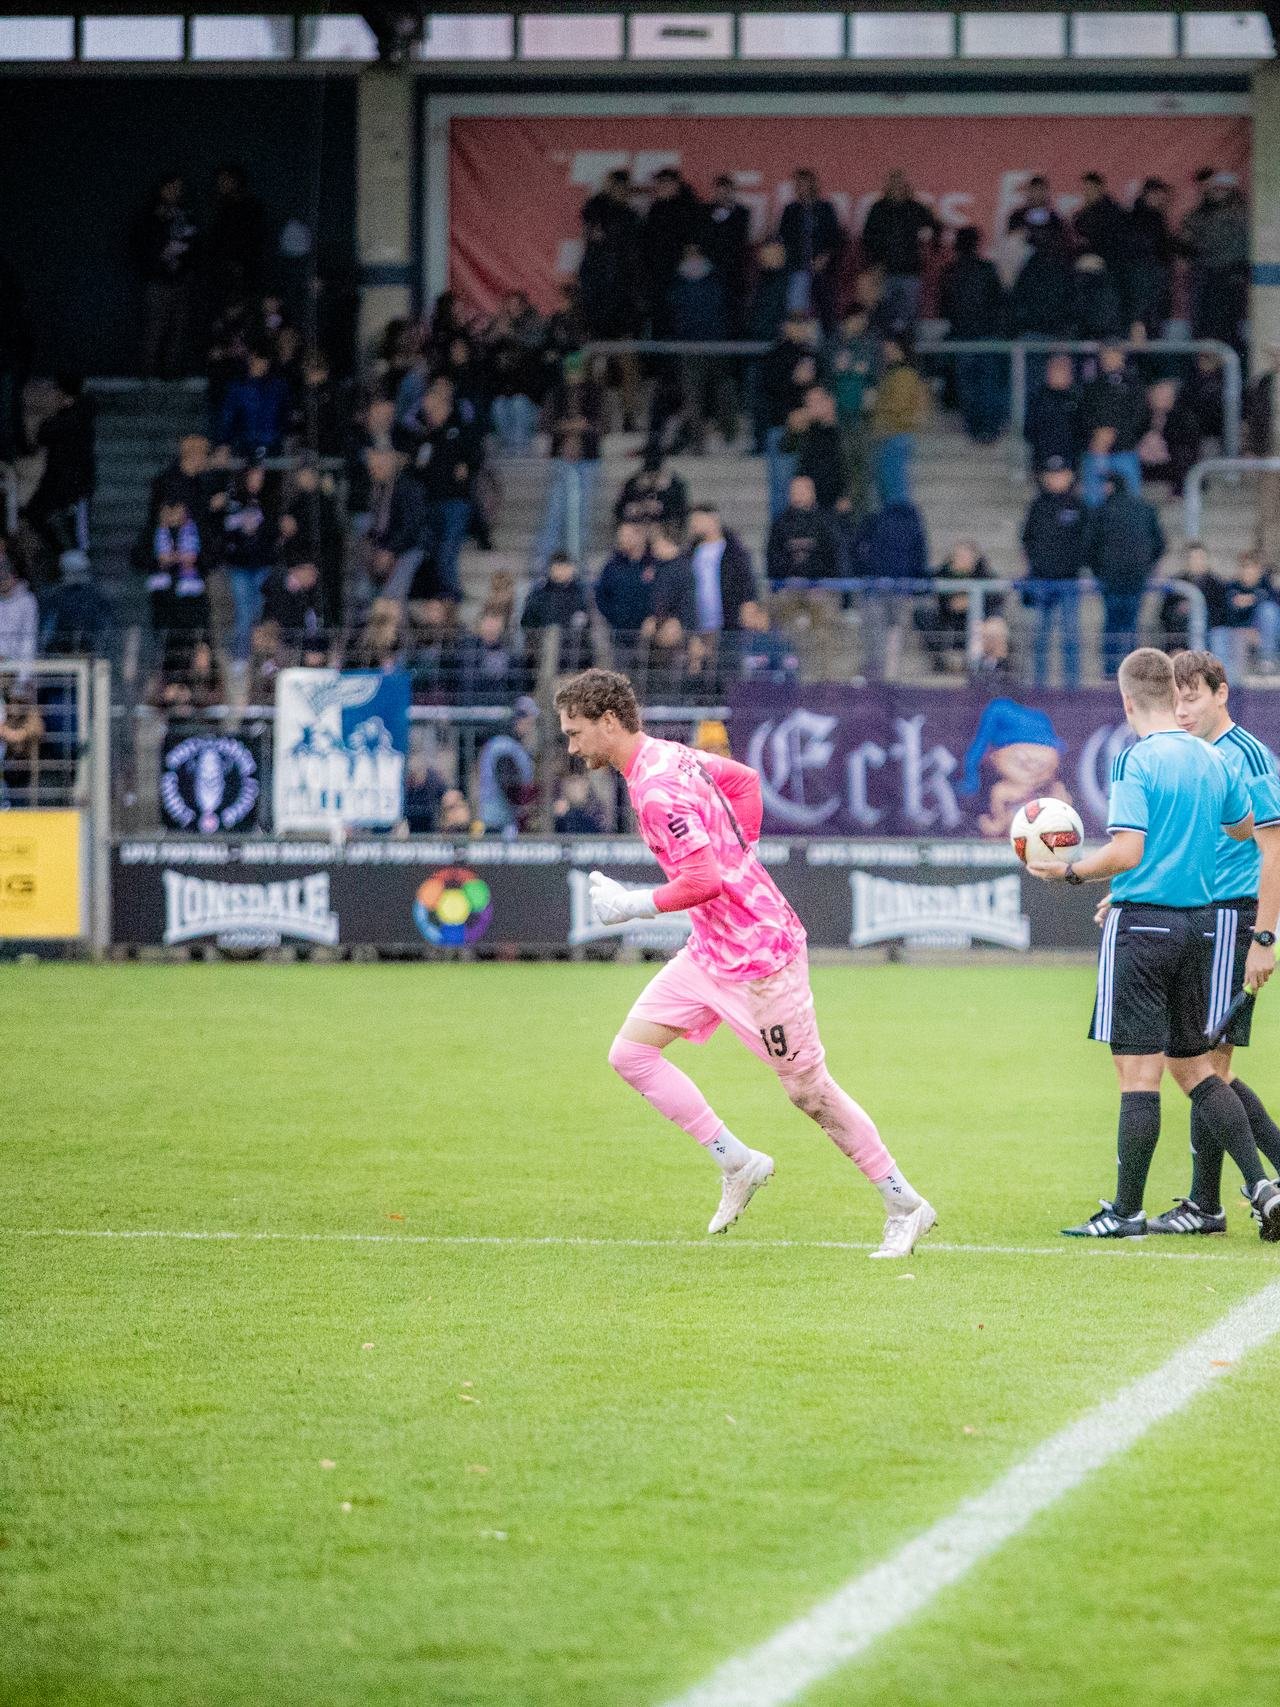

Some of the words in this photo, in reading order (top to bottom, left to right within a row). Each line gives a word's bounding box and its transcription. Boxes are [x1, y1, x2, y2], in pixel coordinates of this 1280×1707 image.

[748, 708, 961, 827] Eck
[162, 869, 340, 945] LONSDALE
[850, 870, 1031, 950] LONSDALE
[760, 1024, 788, 1057] 19
